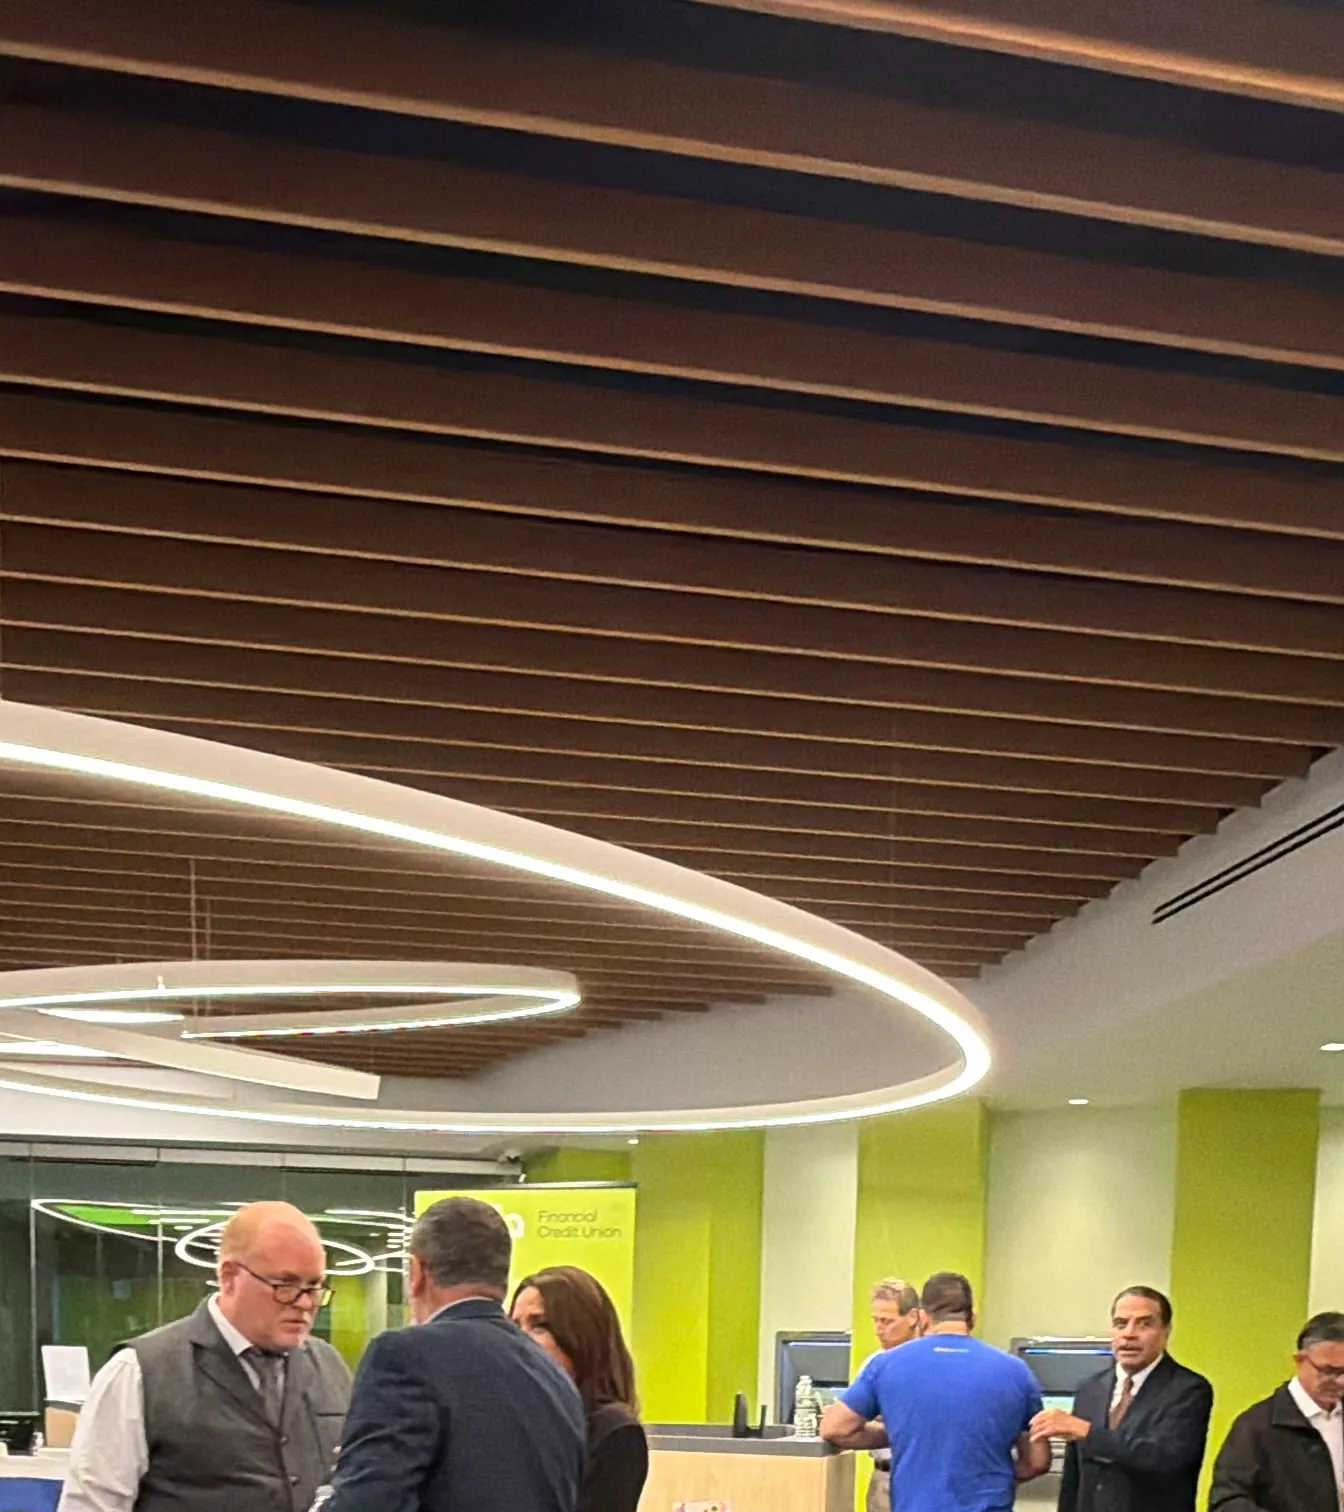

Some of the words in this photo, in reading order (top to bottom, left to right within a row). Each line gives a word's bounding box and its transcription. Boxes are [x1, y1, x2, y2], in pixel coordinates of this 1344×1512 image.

[538, 1210, 597, 1223] Financial
[537, 1226, 578, 1238] Credit
[582, 1227, 621, 1239] Union
